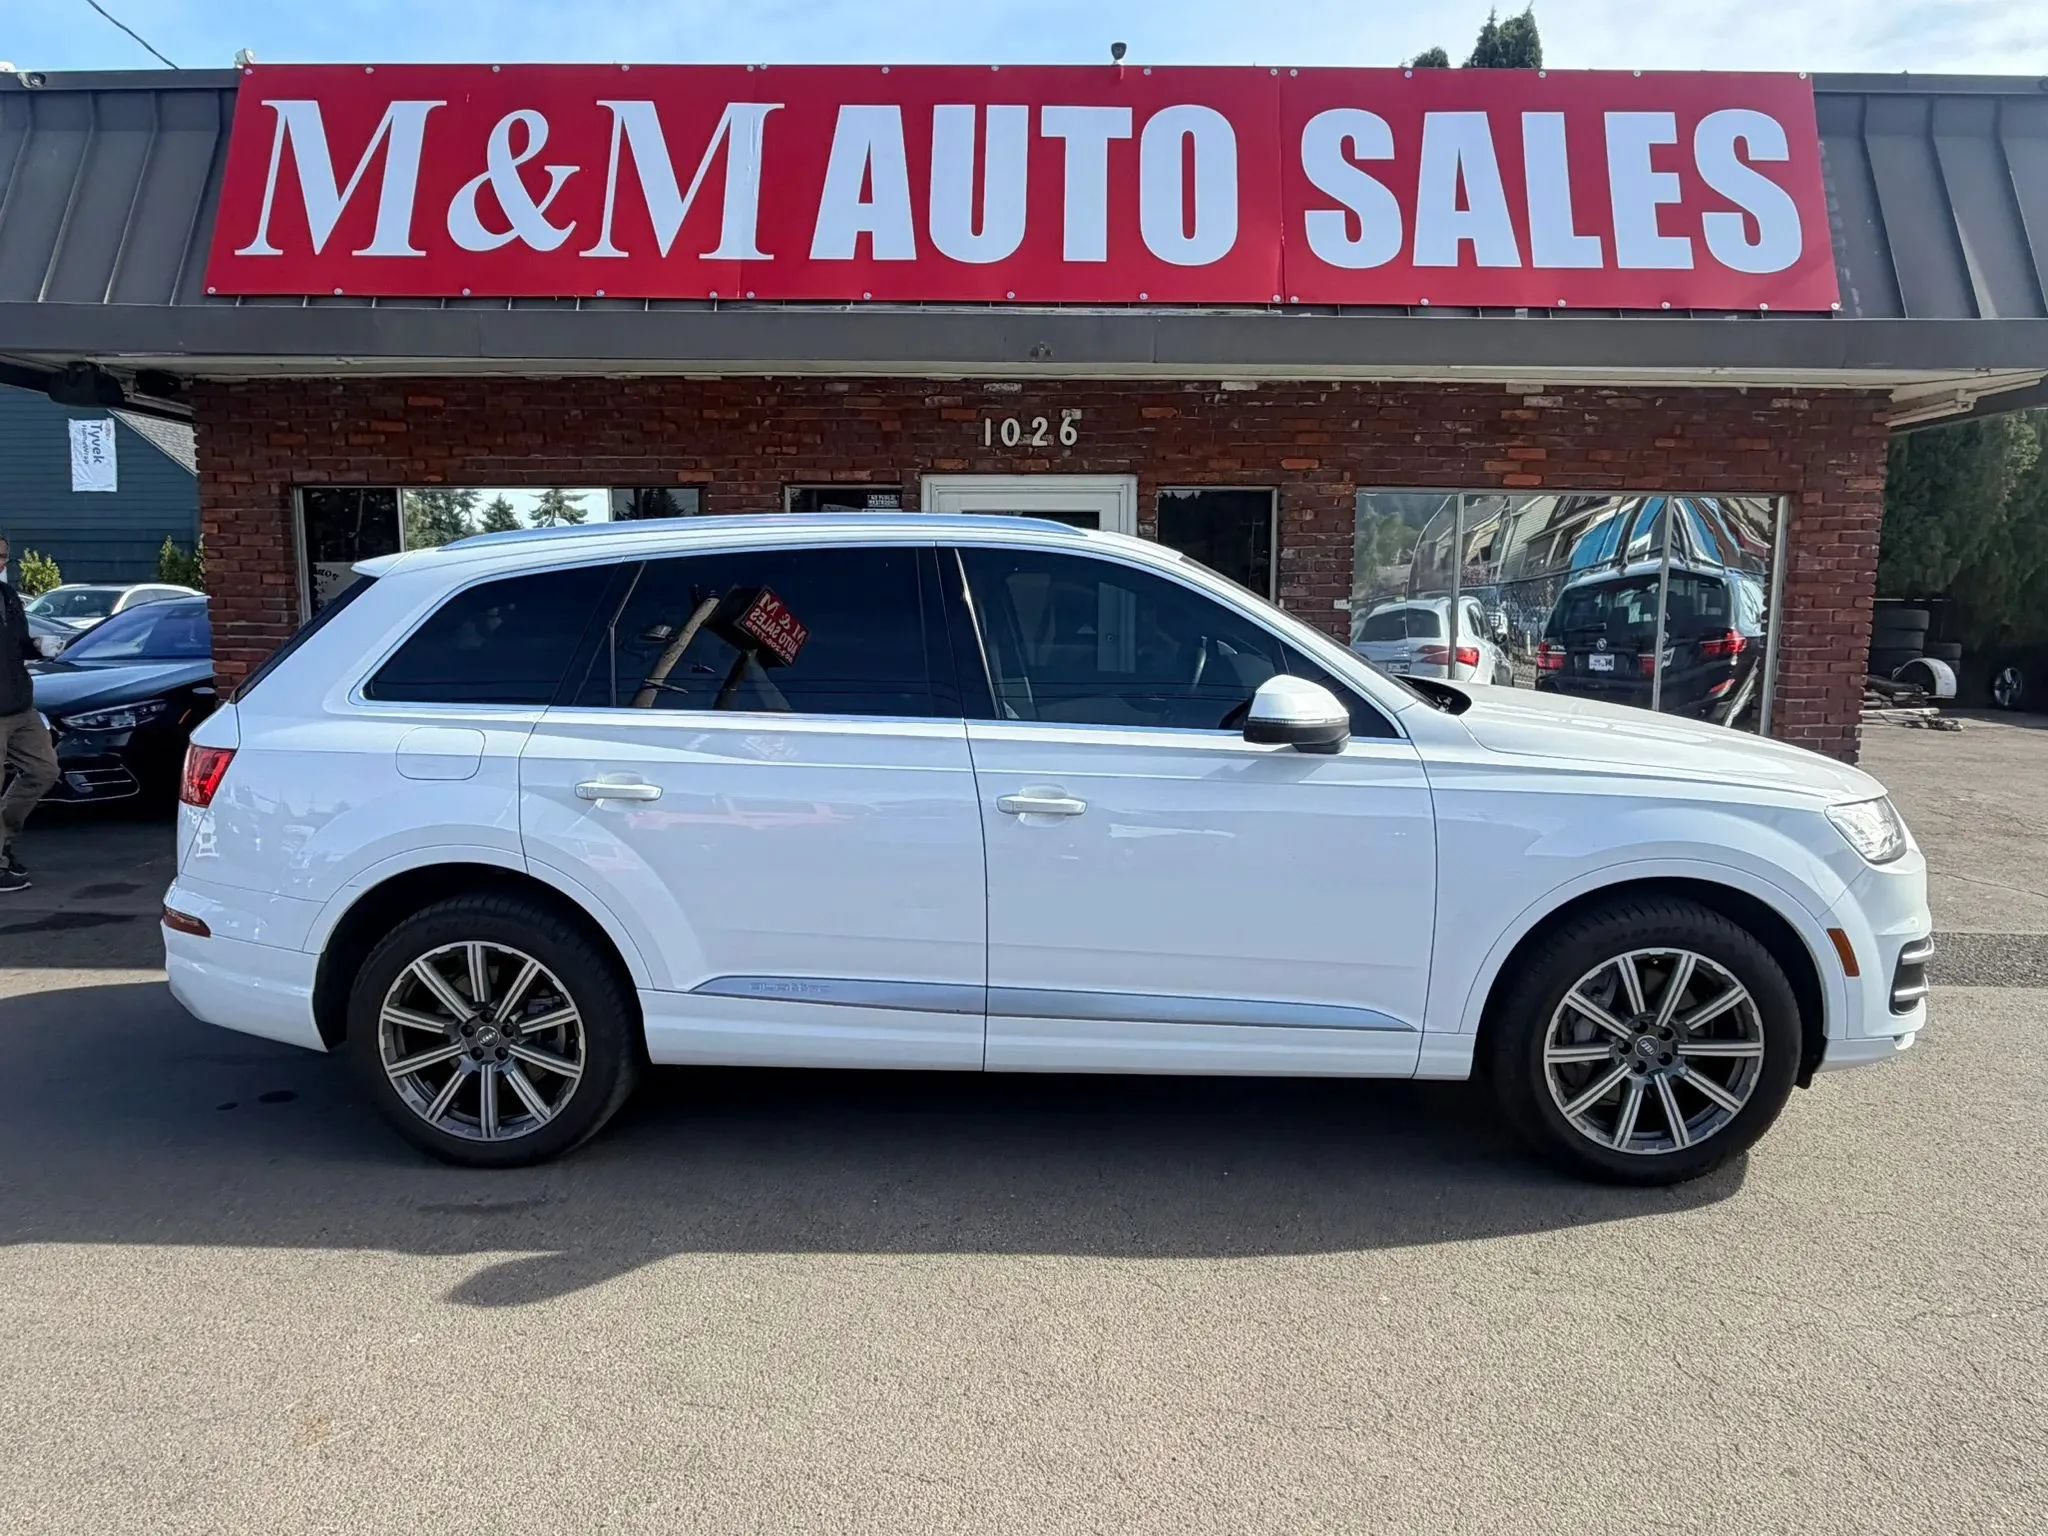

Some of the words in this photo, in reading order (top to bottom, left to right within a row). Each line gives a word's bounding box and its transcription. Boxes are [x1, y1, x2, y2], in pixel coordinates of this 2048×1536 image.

[234, 99, 785, 260] M&M
[808, 103, 1239, 267] AUTO
[1300, 107, 1804, 274] SALES
[87, 424, 105, 464] Tyvek
[984, 416, 1078, 447] 1026
